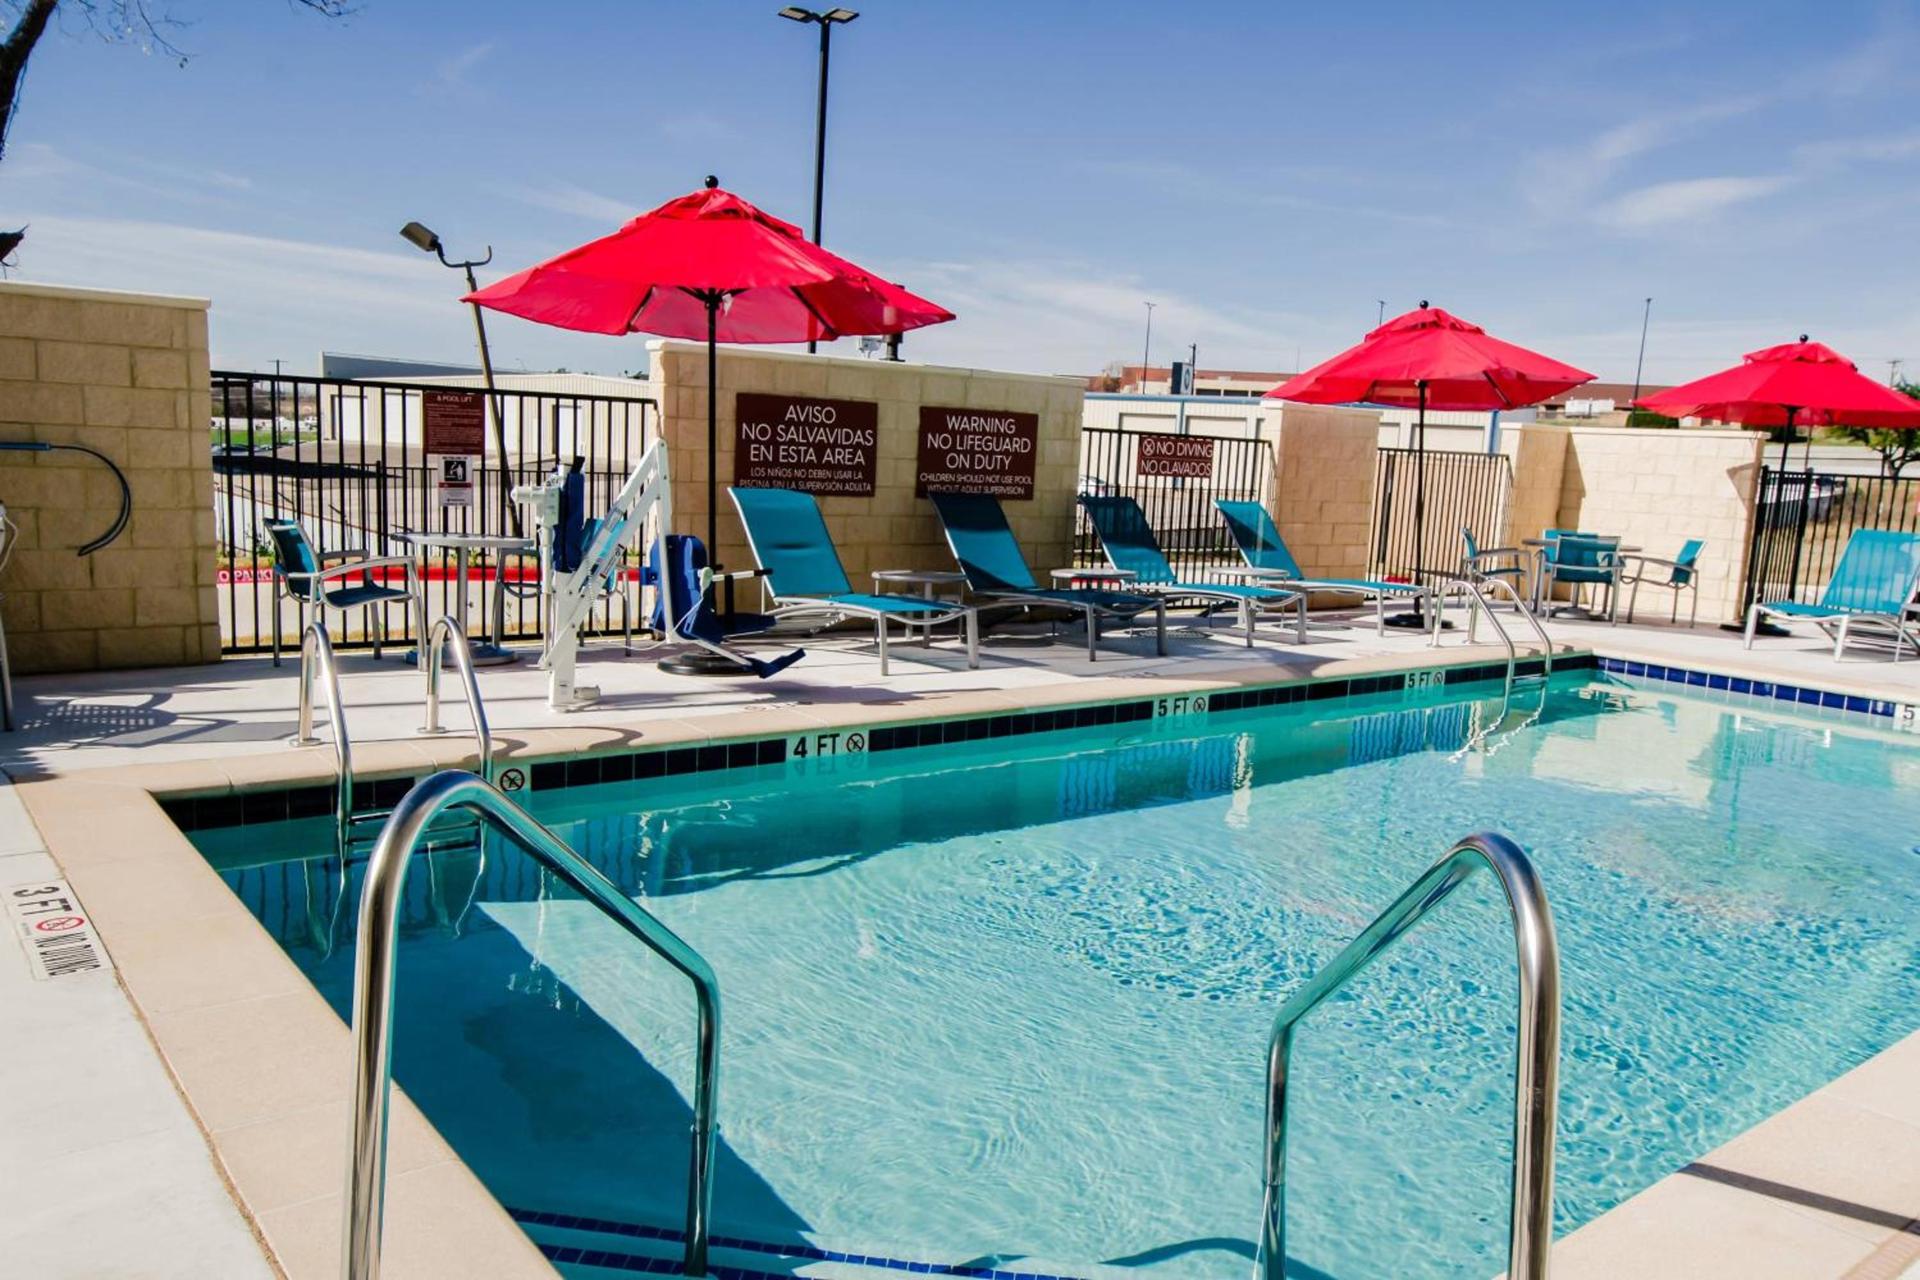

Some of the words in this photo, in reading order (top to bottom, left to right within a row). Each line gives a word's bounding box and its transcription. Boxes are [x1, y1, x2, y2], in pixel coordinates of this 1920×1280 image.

[785, 405, 836, 424] AVISO
[947, 415, 1016, 434] WARNING
[742, 422, 771, 441] NO
[776, 425, 874, 446] SALVAVIDAS
[927, 433, 952, 450] NO
[956, 434, 1031, 453] LIFEGUARD
[1157, 442, 1174, 456] NO
[1177, 443, 1213, 457] DIVING
[750, 444, 773, 461] EN
[779, 445, 817, 463] ESTA
[822, 448, 866, 466] AREA
[946, 452, 970, 469] ON
[974, 453, 1012, 470] DUTY
[750, 467, 765, 477] LOS
[767, 466, 792, 478] NIÑOS
[794, 468, 806, 478] NO
[808, 469, 831, 479] DEBEN
[834, 470, 852, 480] USAR
[854, 471, 863, 480] LA
[1141, 460, 1157, 473] NO
[1159, 461, 1211, 477] CLAVADOS
[739, 480, 770, 489] PISCINA
[786, 480, 796, 490] LA
[844, 482, 872, 492] ADULTA
[920, 472, 955, 482] CHILDREN
[956, 474, 984, 484] SHOULD
[985, 475, 1000, 484] NOT
[1001, 475, 1013, 484] USE
[1014, 475, 1033, 485] POOL
[960, 484, 982, 494] ADULT
[218, 570, 230, 582] O
[1408, 672, 1416, 688] 5
[1418, 671, 1431, 687] FT
[1158, 698, 1168, 717] 5
[1173, 697, 1189, 716] FT
[1903, 704, 1915, 720] 5
[793, 736, 808, 758] 4
[816, 733, 840, 756] FT
[13, 886, 60, 898] 3
[17, 898, 72, 916] FT
